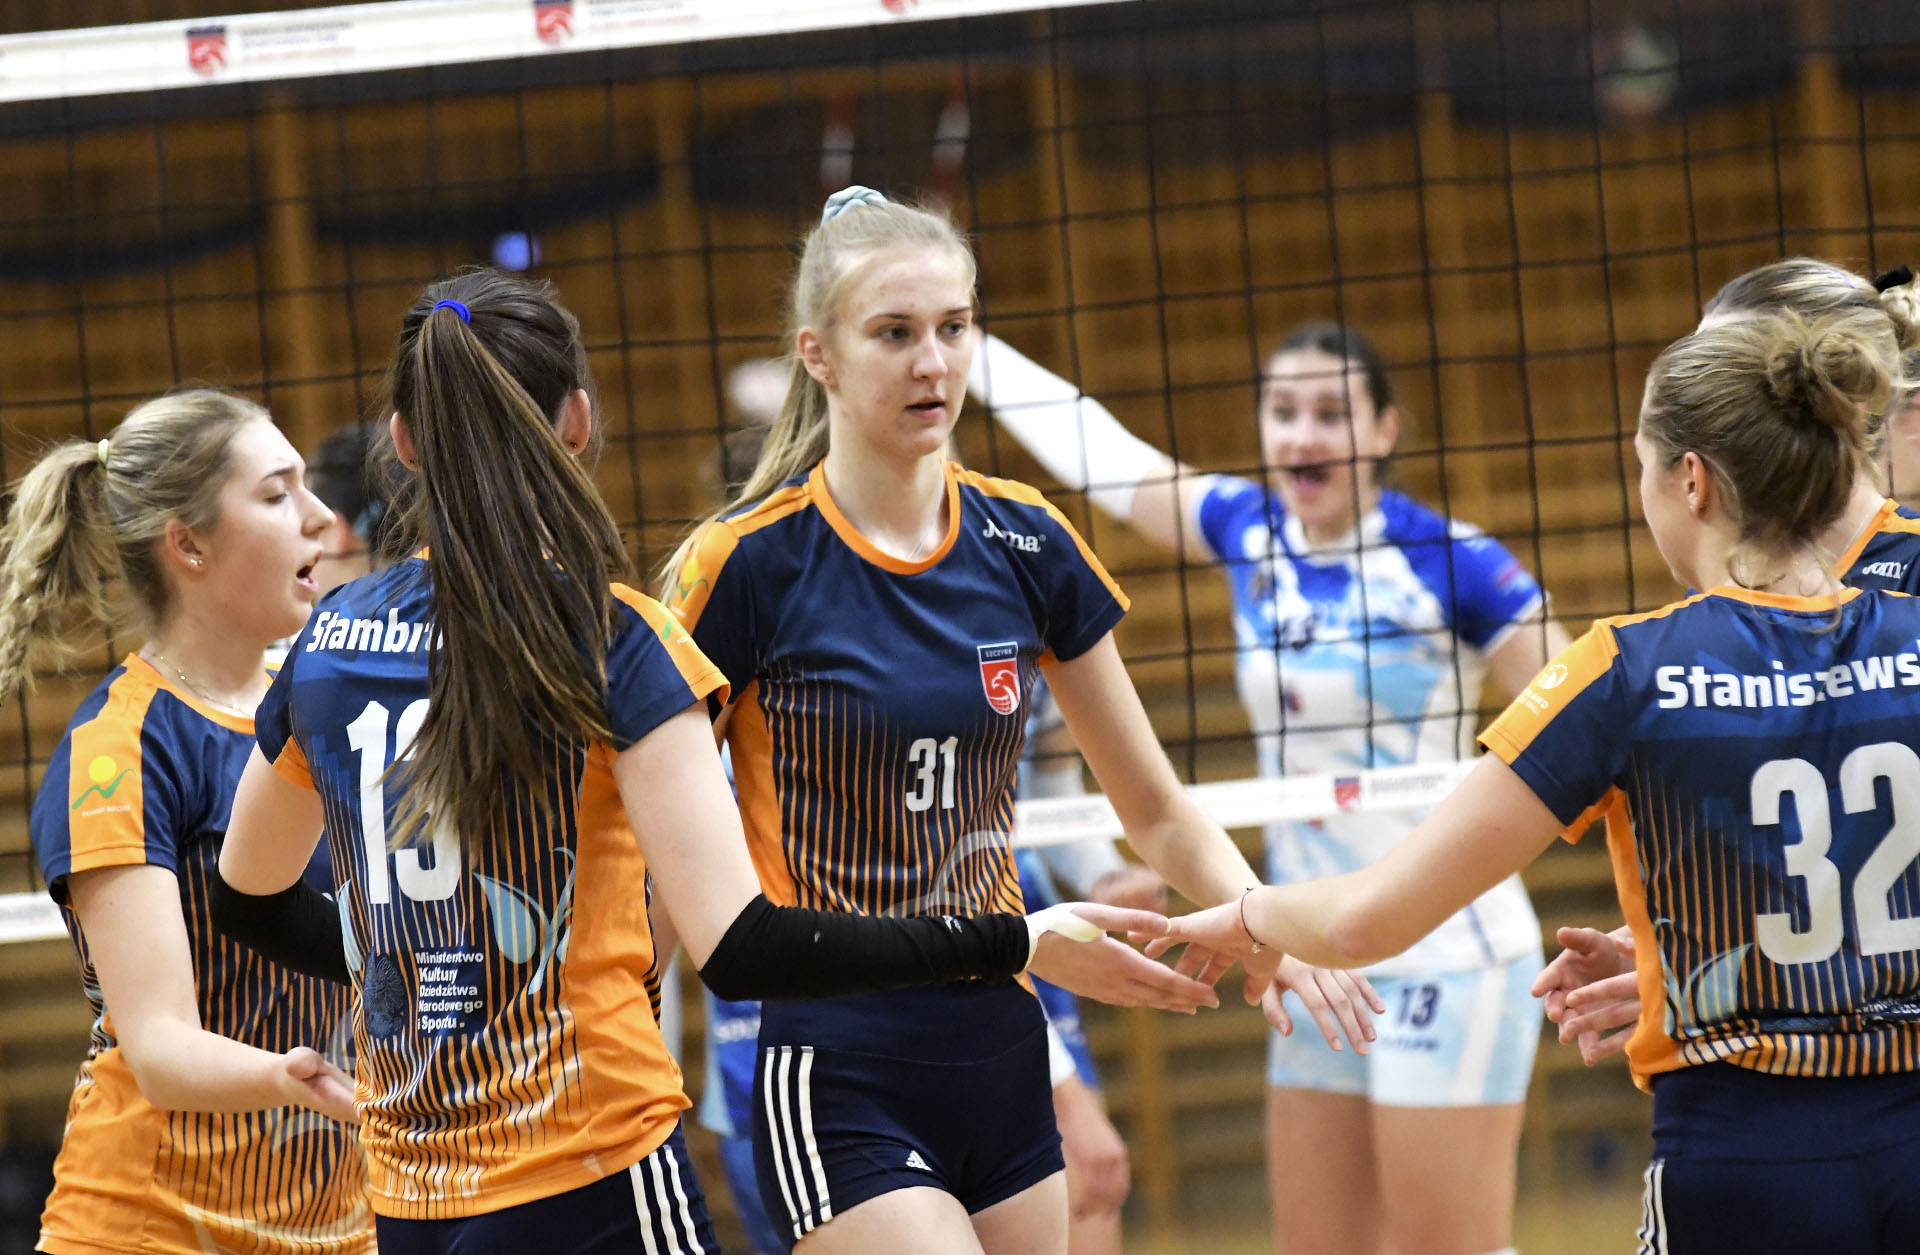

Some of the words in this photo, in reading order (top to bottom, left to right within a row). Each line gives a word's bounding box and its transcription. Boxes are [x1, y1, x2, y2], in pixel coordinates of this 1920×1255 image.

[1656, 652, 1920, 709] Staniszews
[905, 736, 959, 812] 31
[1751, 741, 1920, 965] 32
[418, 966, 458, 985] Kultury
[419, 984, 478, 997] Dziedzictwa
[418, 1000, 484, 1014] Narodowego
[1399, 983, 1441, 1029] 13
